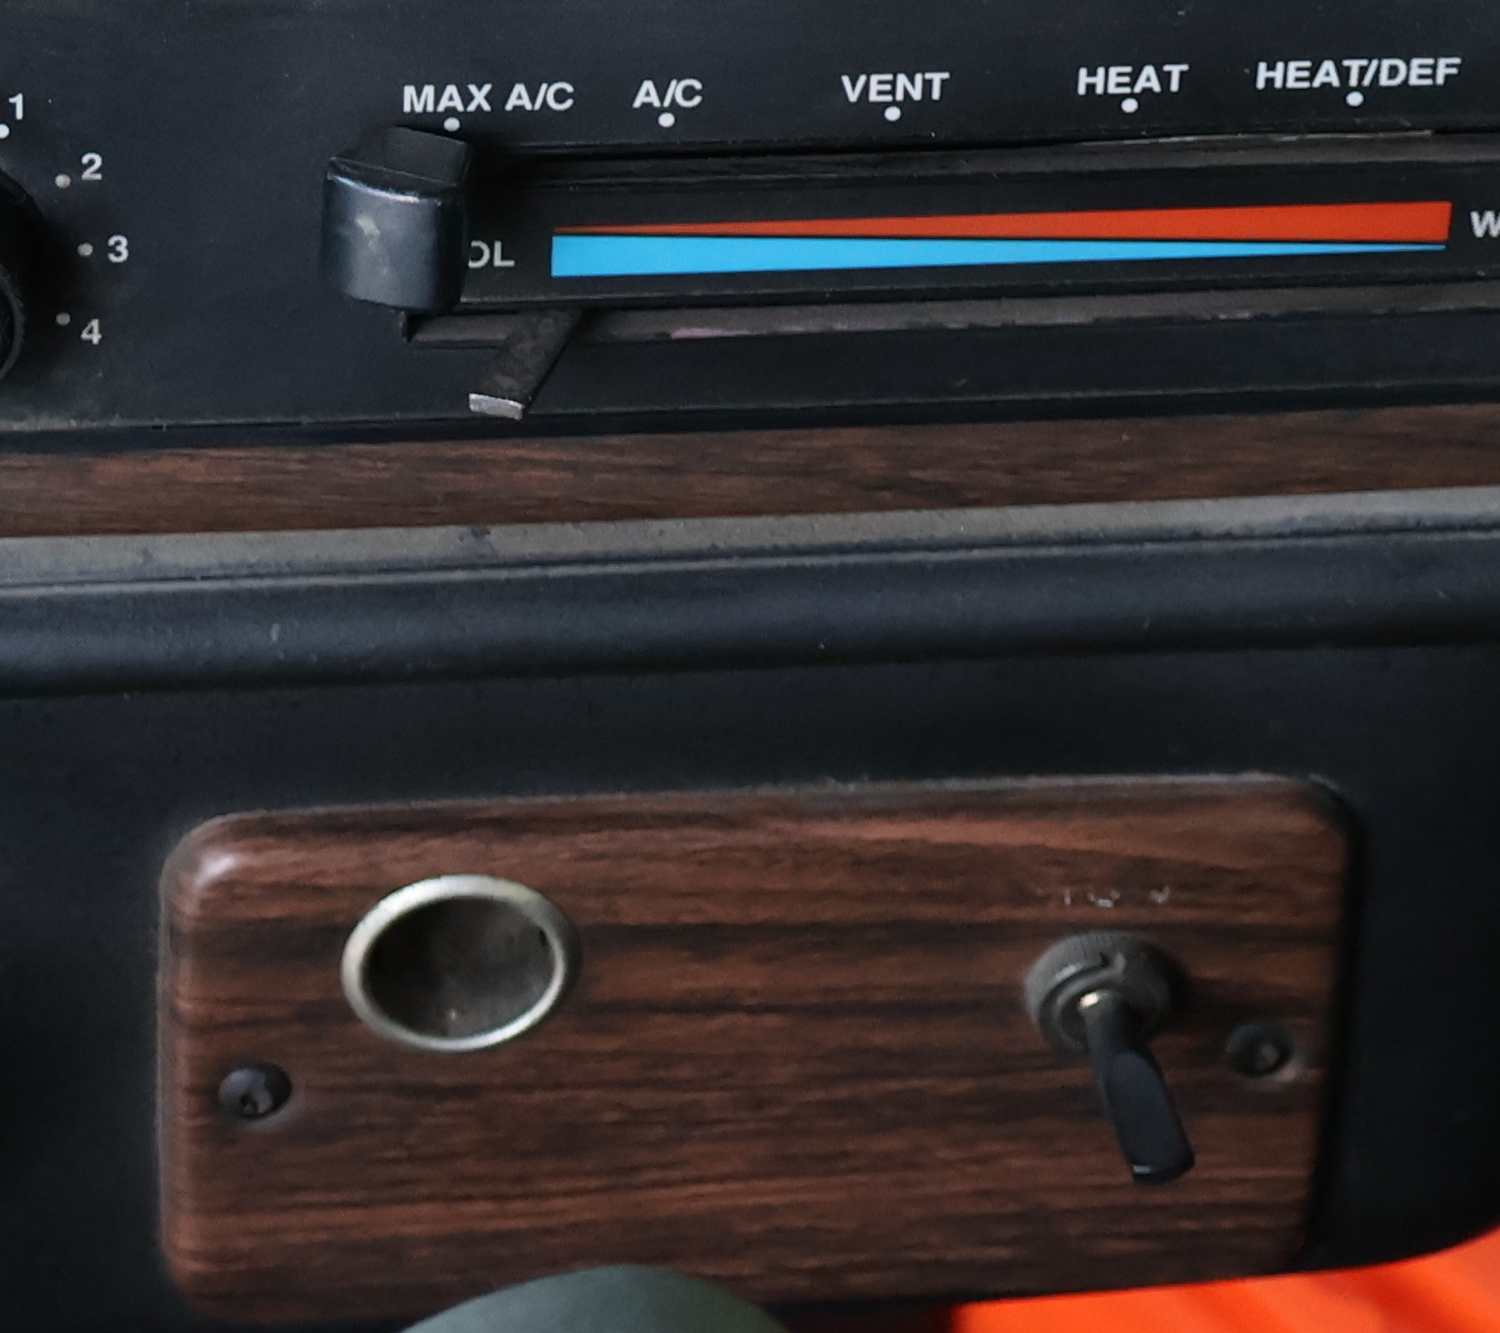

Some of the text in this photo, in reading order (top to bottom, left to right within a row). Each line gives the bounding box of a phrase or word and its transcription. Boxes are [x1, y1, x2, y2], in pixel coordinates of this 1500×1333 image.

[841, 72, 950, 103] VENT
[1076, 63, 1189, 96] HEAT
[1255, 56, 1462, 90] HEAT/DEF
[8, 94, 23, 120] 1
[403, 81, 574, 114] MAX A/C
[633, 78, 703, 109] A/C
[81, 153, 103, 181] 2
[107, 235, 129, 263] 3
[468, 240, 516, 269] OL
[80, 319, 102, 344] 4
